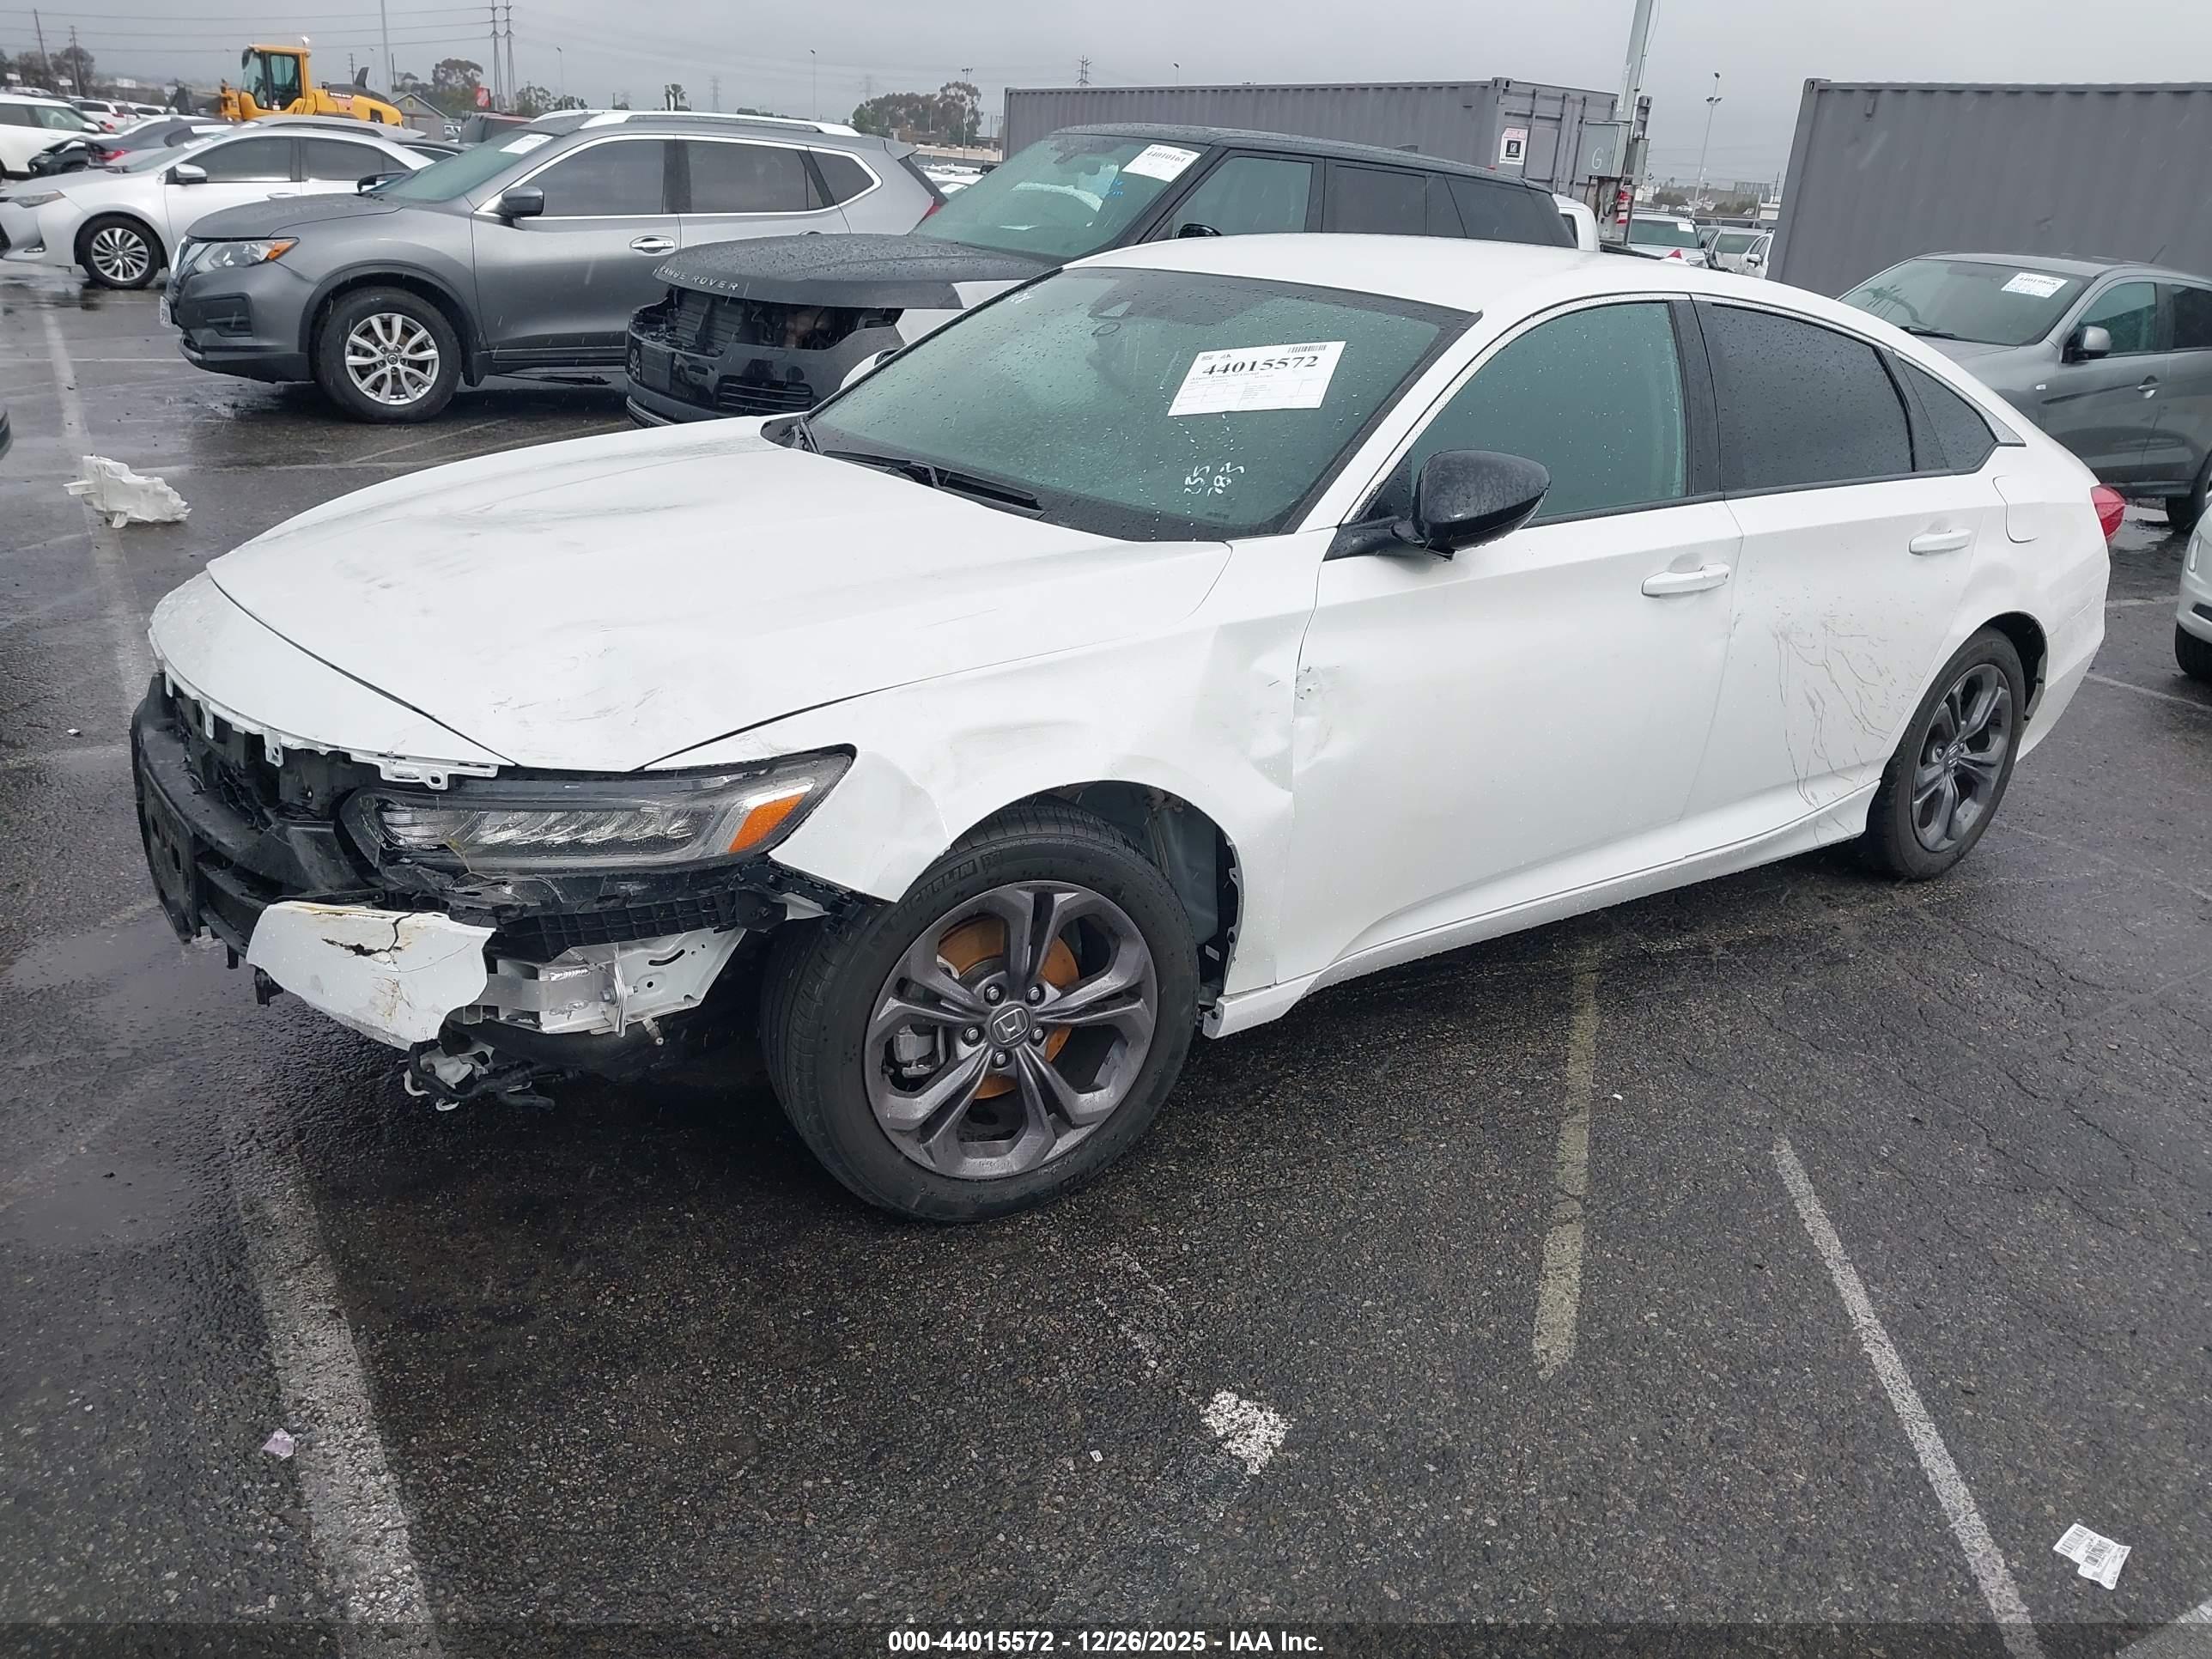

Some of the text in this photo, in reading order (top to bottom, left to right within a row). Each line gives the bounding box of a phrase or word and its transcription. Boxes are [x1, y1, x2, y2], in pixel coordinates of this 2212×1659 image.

[658, 265, 739, 291] RANGE ROVER
[1202, 355, 1320, 375] 44015572
[888, 859, 978, 929] MICHELIN
